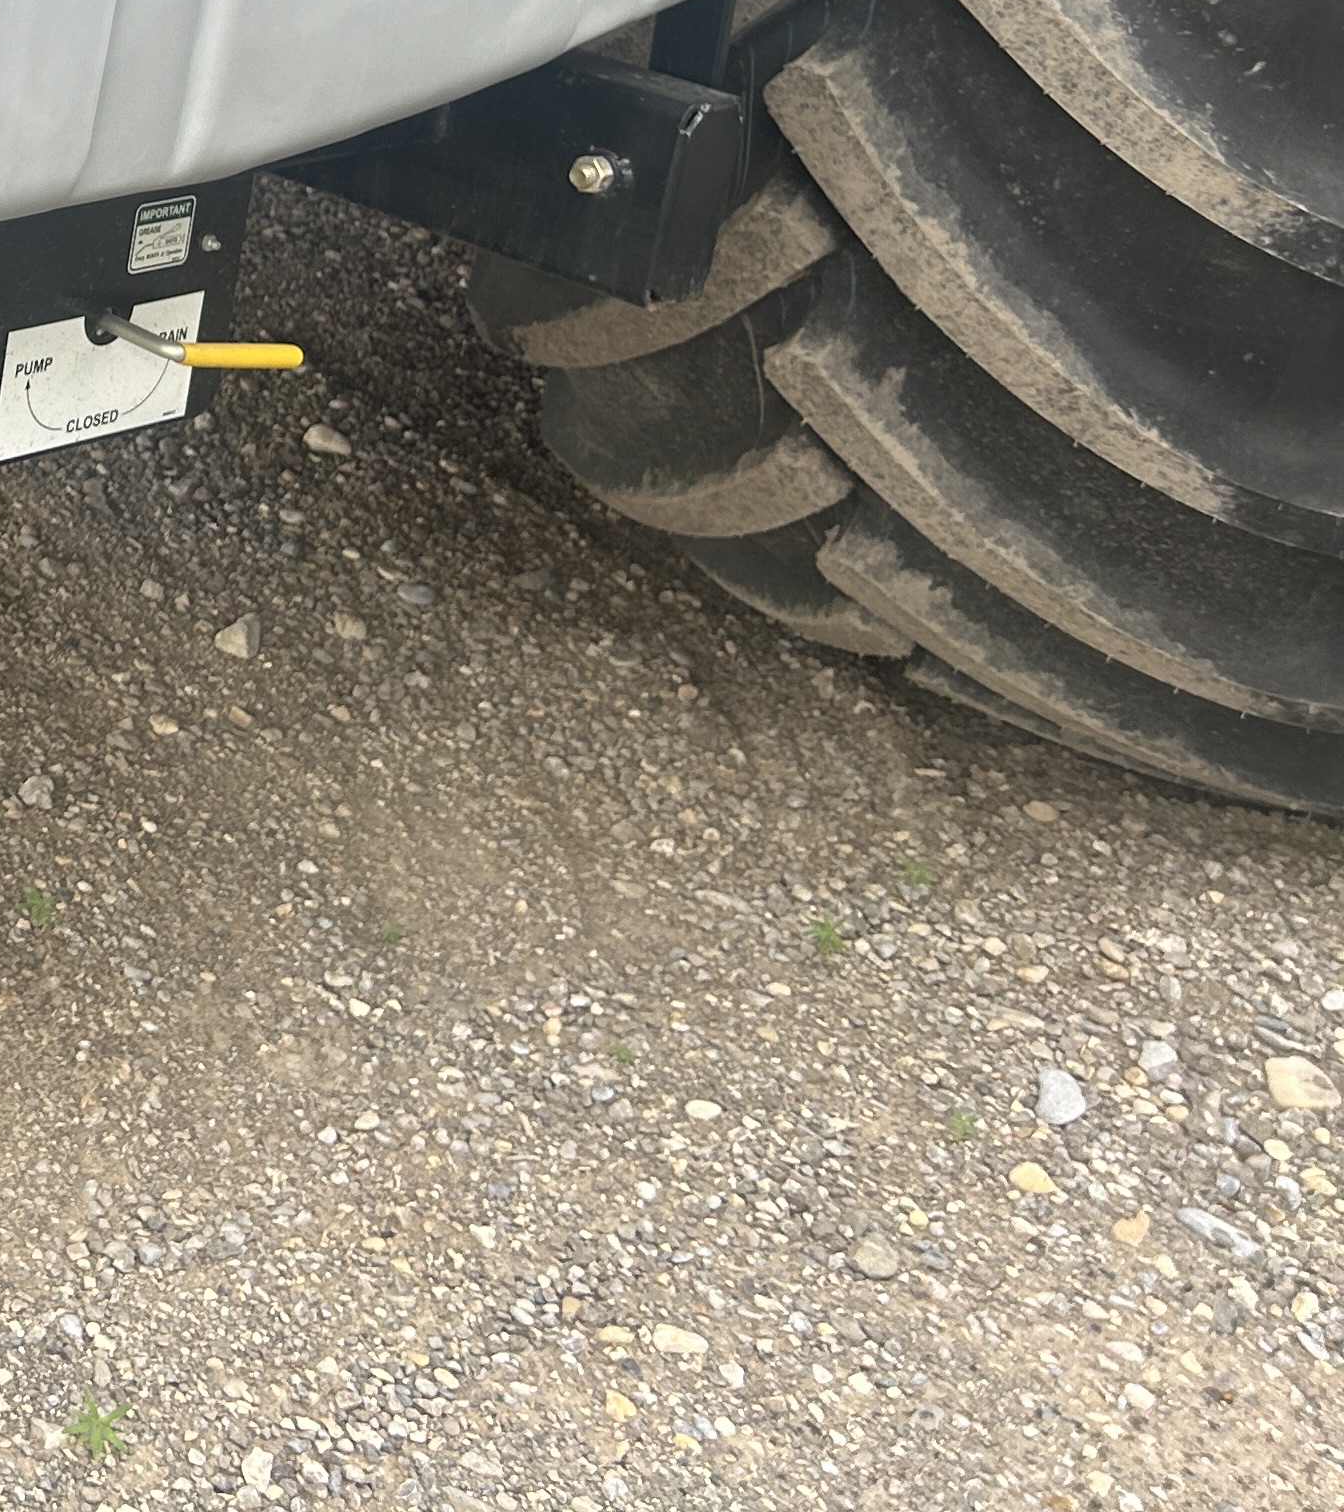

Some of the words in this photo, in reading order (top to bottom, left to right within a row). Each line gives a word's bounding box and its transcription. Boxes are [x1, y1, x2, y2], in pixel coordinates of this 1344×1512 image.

[140, 201, 192, 221] IMPORTANT
[159, 326, 188, 342] RAIN
[15, 356, 54, 378] PUMP
[65, 408, 119, 433] CLOSED
